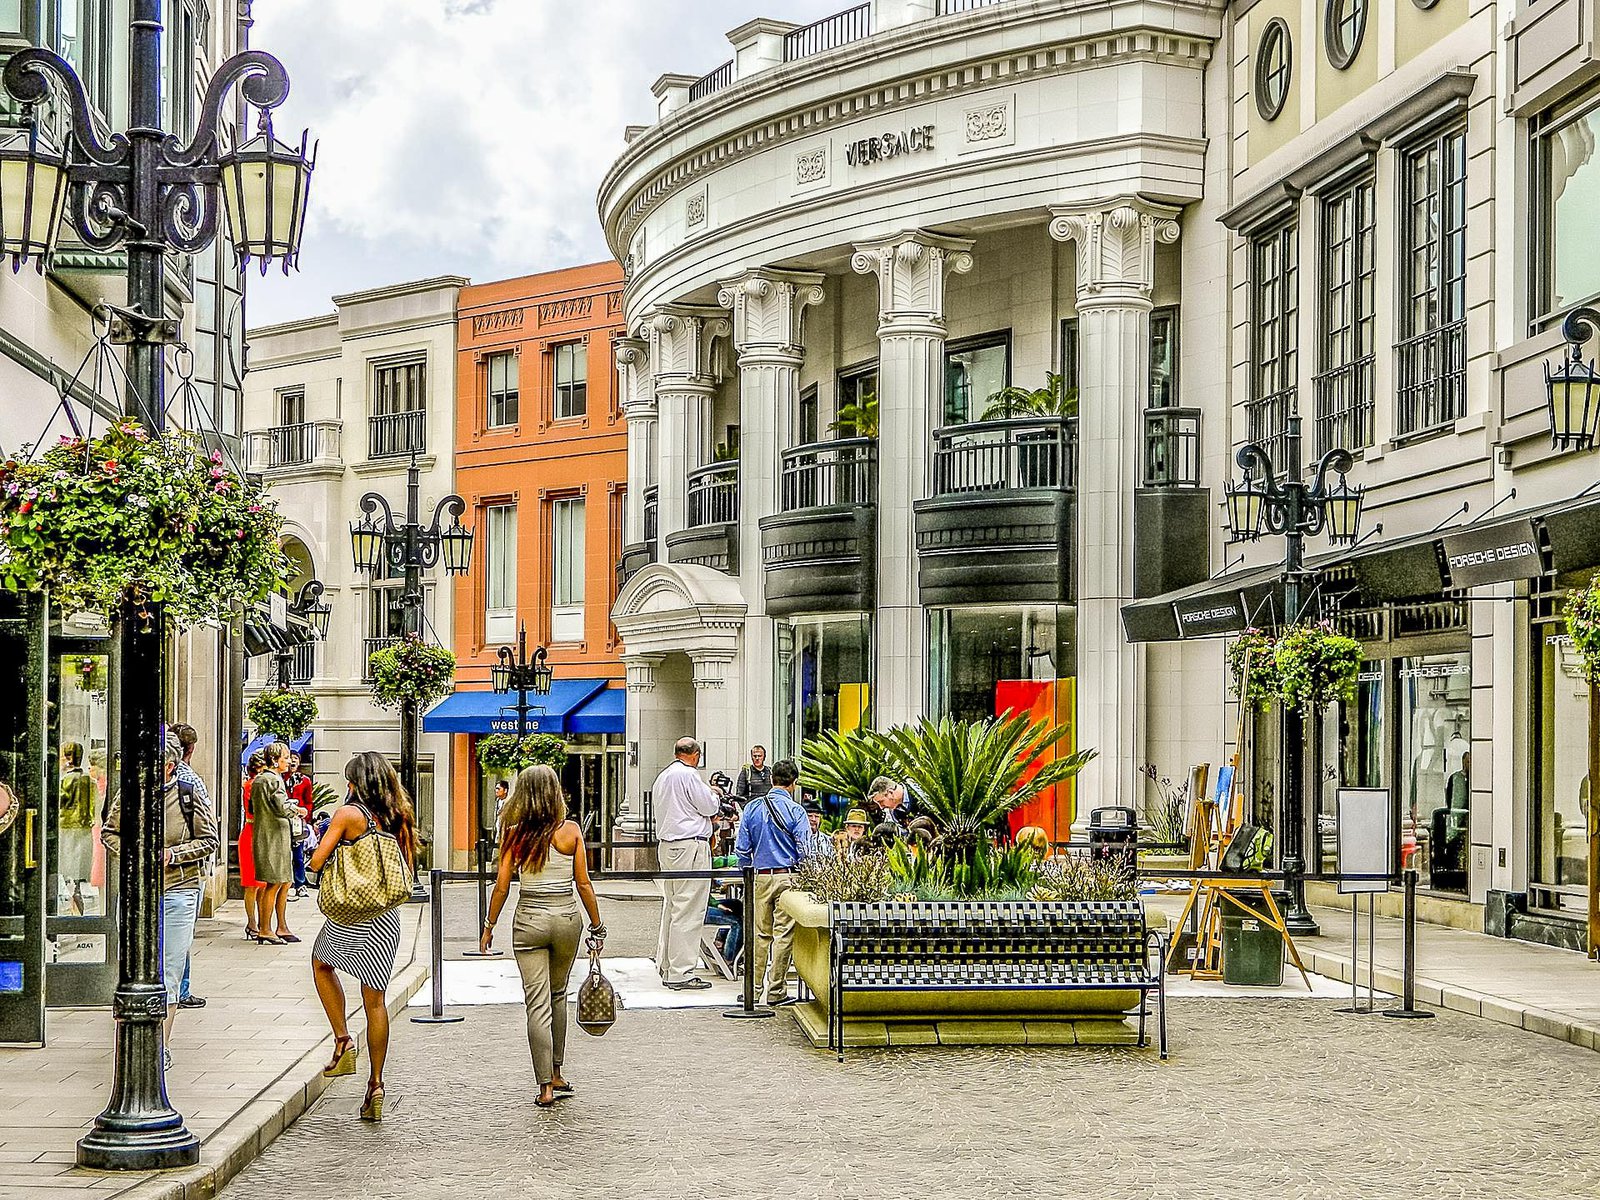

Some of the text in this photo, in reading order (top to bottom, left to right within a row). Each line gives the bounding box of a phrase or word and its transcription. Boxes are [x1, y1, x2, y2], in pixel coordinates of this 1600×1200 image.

[845, 125, 935, 167] VERSACE
[1449, 541, 1536, 569] PORSCHE DESIGN
[1182, 605, 1237, 624] PORSCHE DESIGN
[1546, 634, 1575, 646] PORS
[1358, 672, 1383, 681] DESIG
[1399, 666, 1439, 679] PORSCHE
[491, 720, 539, 730] westne
